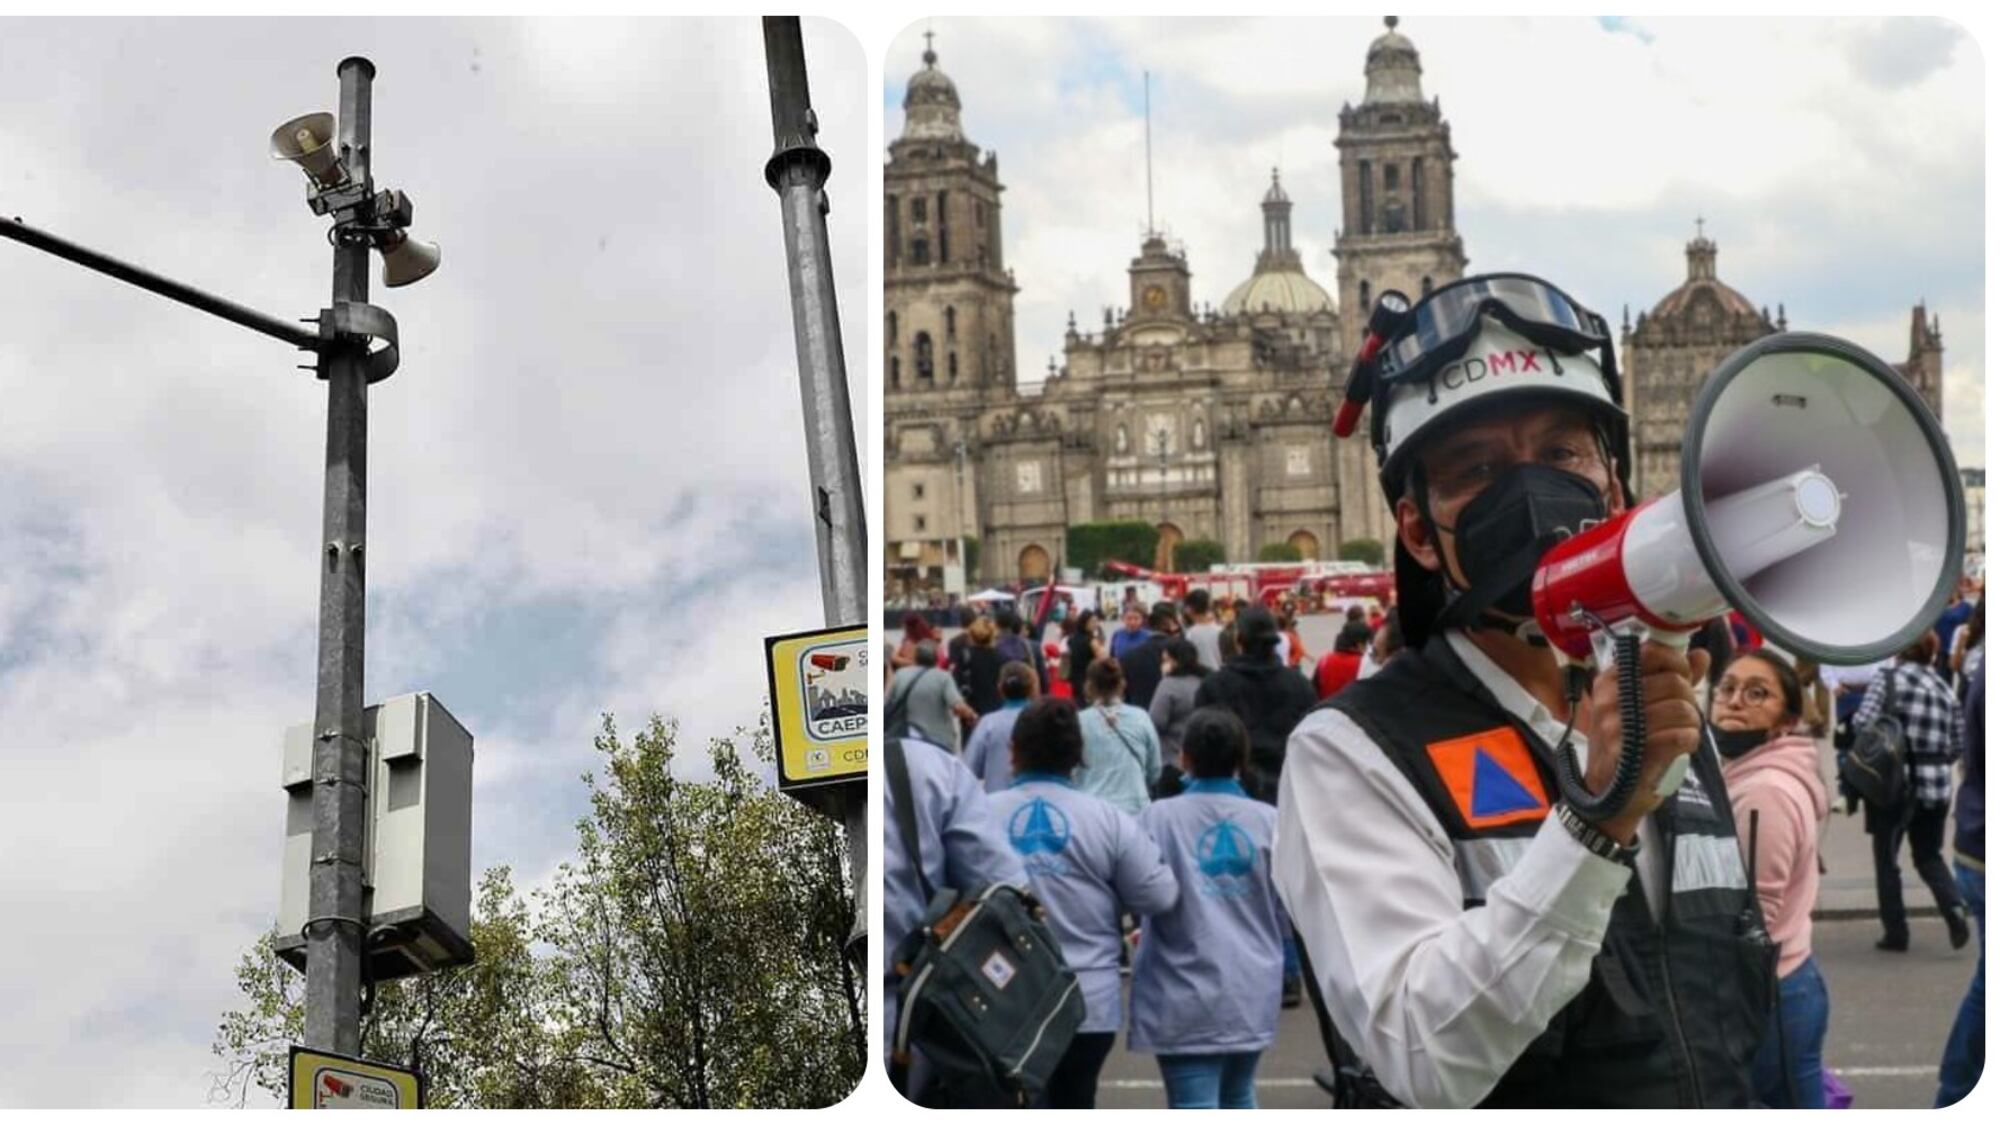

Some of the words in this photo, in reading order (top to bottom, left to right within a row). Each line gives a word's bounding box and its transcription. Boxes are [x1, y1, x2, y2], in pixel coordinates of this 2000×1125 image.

[1442, 349, 1542, 390] CDMX
[818, 716, 867, 734] CAEP
[843, 749, 868, 762] CD
